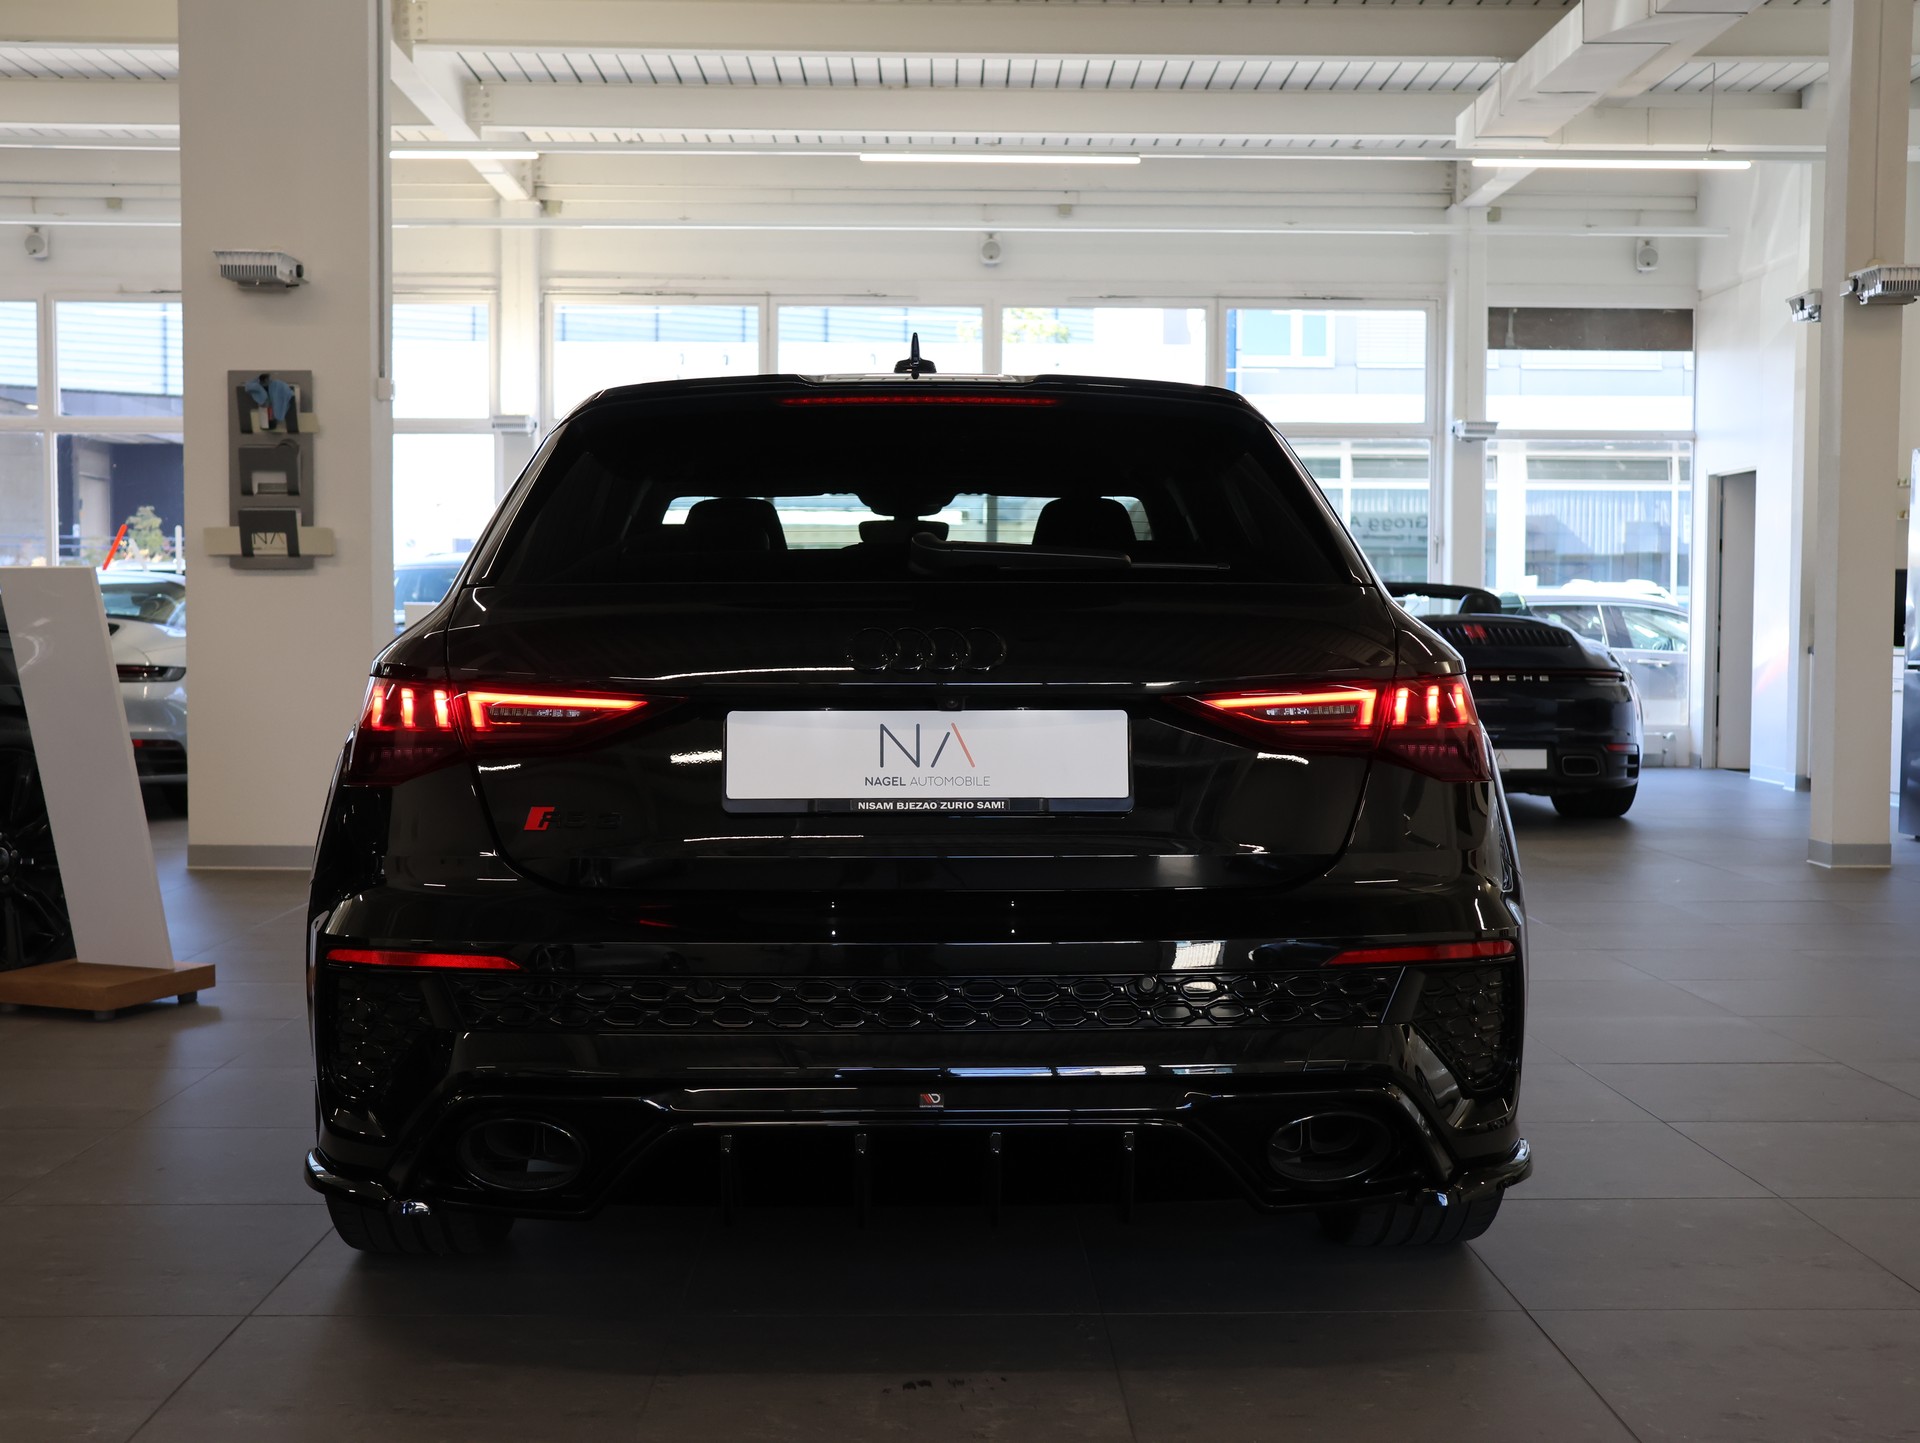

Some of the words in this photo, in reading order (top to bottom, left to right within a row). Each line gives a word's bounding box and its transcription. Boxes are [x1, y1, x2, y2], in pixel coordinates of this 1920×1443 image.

[864, 776, 907, 787] NAGEL
[909, 776, 991, 787] AUTOMOBILE
[857, 801, 894, 810] NISAM
[896, 801, 938, 810] BJEZAO
[940, 801, 975, 810] ZURIO
[976, 801, 1006, 810] SAM!
